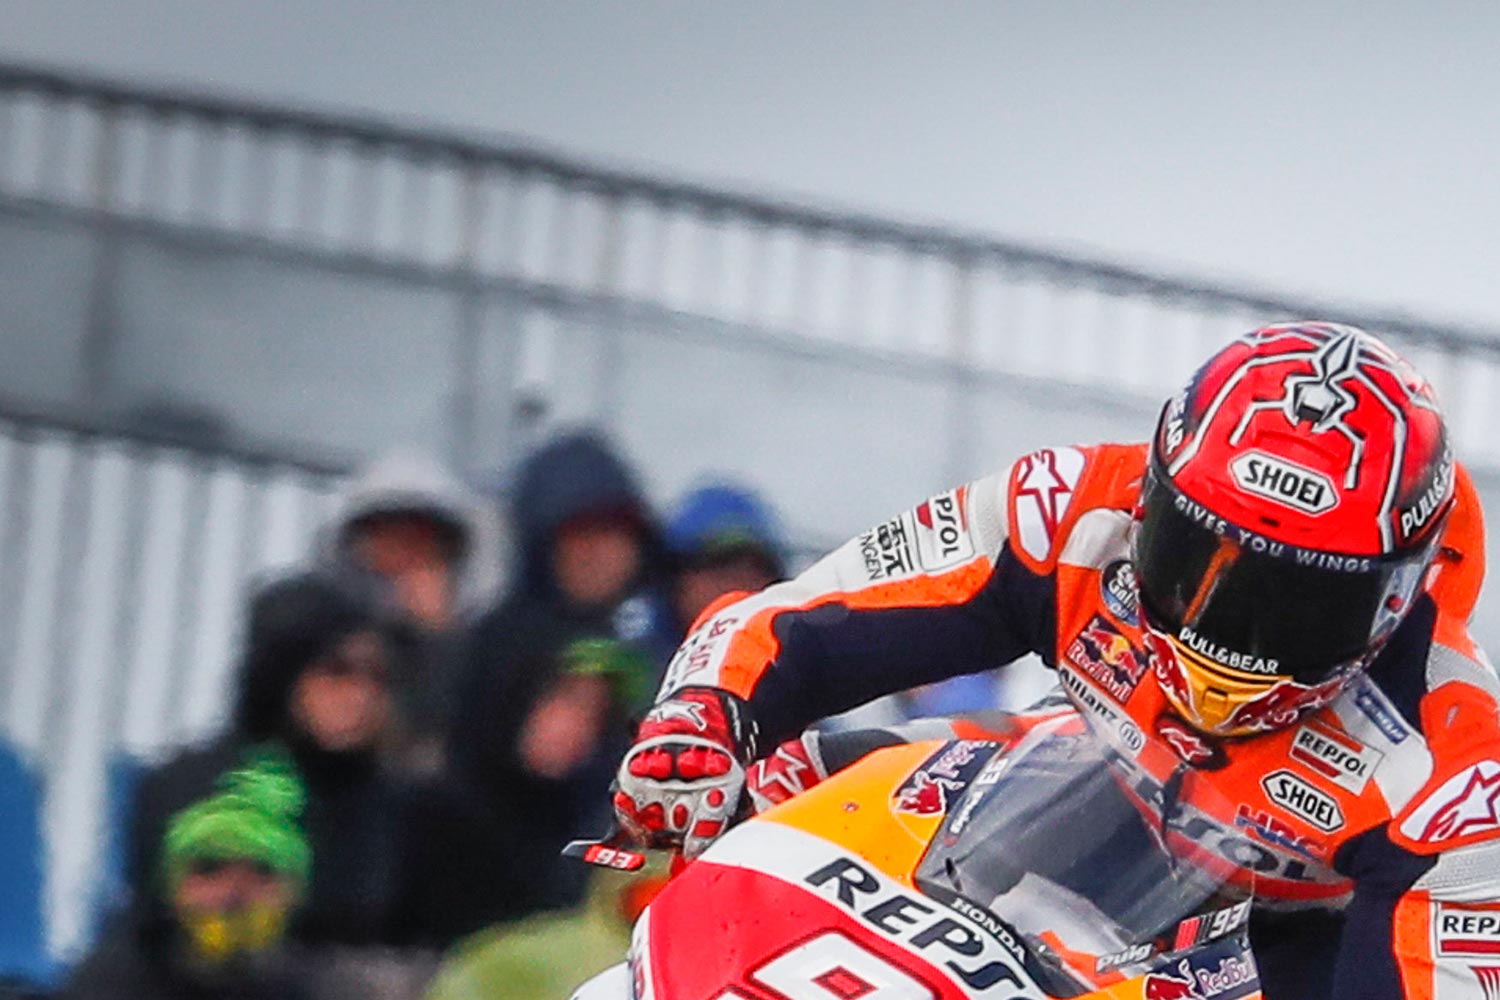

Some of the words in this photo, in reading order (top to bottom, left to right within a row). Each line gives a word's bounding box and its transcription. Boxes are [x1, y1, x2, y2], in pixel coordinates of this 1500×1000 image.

[1244, 459, 1325, 508] SHOEI
[935, 496, 959, 559] PSOL
[1173, 493, 1227, 535] GIVES
[1238, 528, 1284, 559] YOU
[1296, 549, 1371, 573] WINGS
[1178, 627, 1280, 675] PULL&BEAR
[1059, 667, 1120, 722] Allianz
[1299, 730, 1368, 778] REPSOL
[1274, 779, 1336, 828] SHOEI
[1235, 804, 1328, 863] HRC
[594, 849, 634, 869] 93
[950, 897, 1026, 966] HONDA
[1208, 904, 1248, 940] 93
[1096, 942, 1154, 973] Puig
